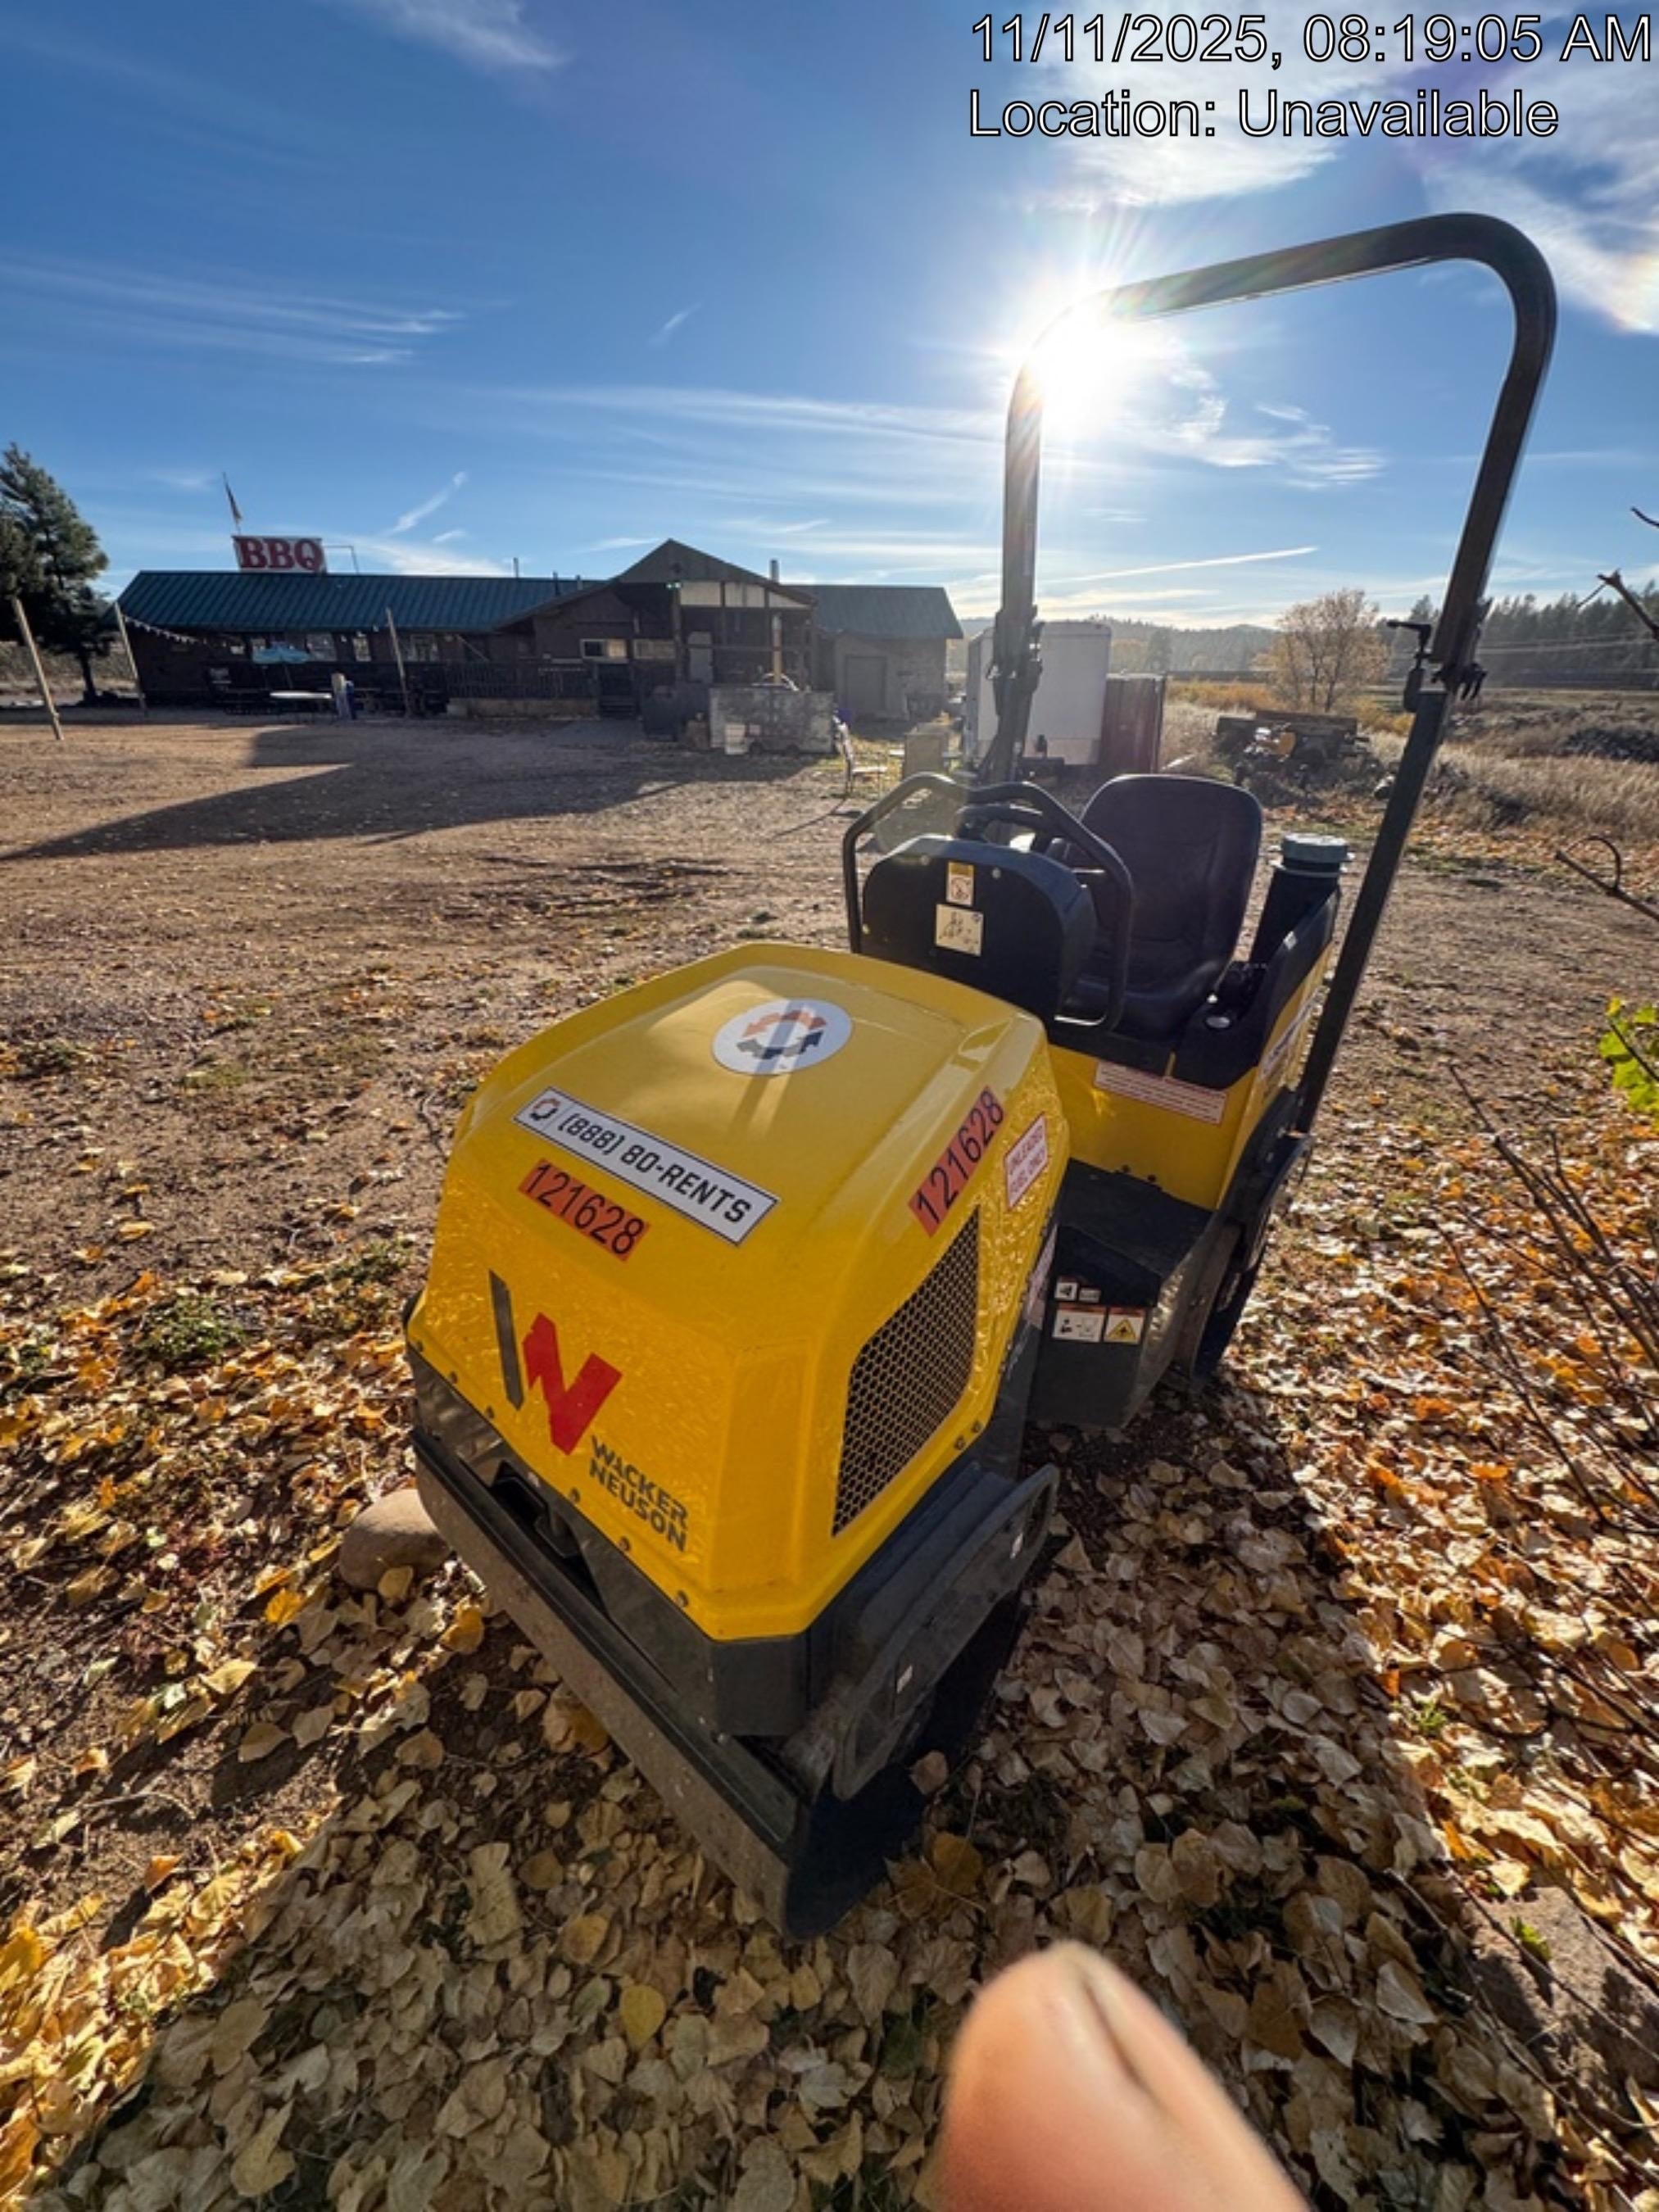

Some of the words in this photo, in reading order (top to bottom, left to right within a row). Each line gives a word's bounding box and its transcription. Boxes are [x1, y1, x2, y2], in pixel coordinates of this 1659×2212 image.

[235, 537, 325, 571] BBQ
[557, 1113, 626, 1156] (888)
[620, 1145, 751, 1223] 80-RENTS
[917, 1090, 1004, 1225] 121628
[526, 1163, 646, 1255] 121628
[589, 1459, 687, 1553] NEUSON
[592, 1435, 690, 1530] WACKER
